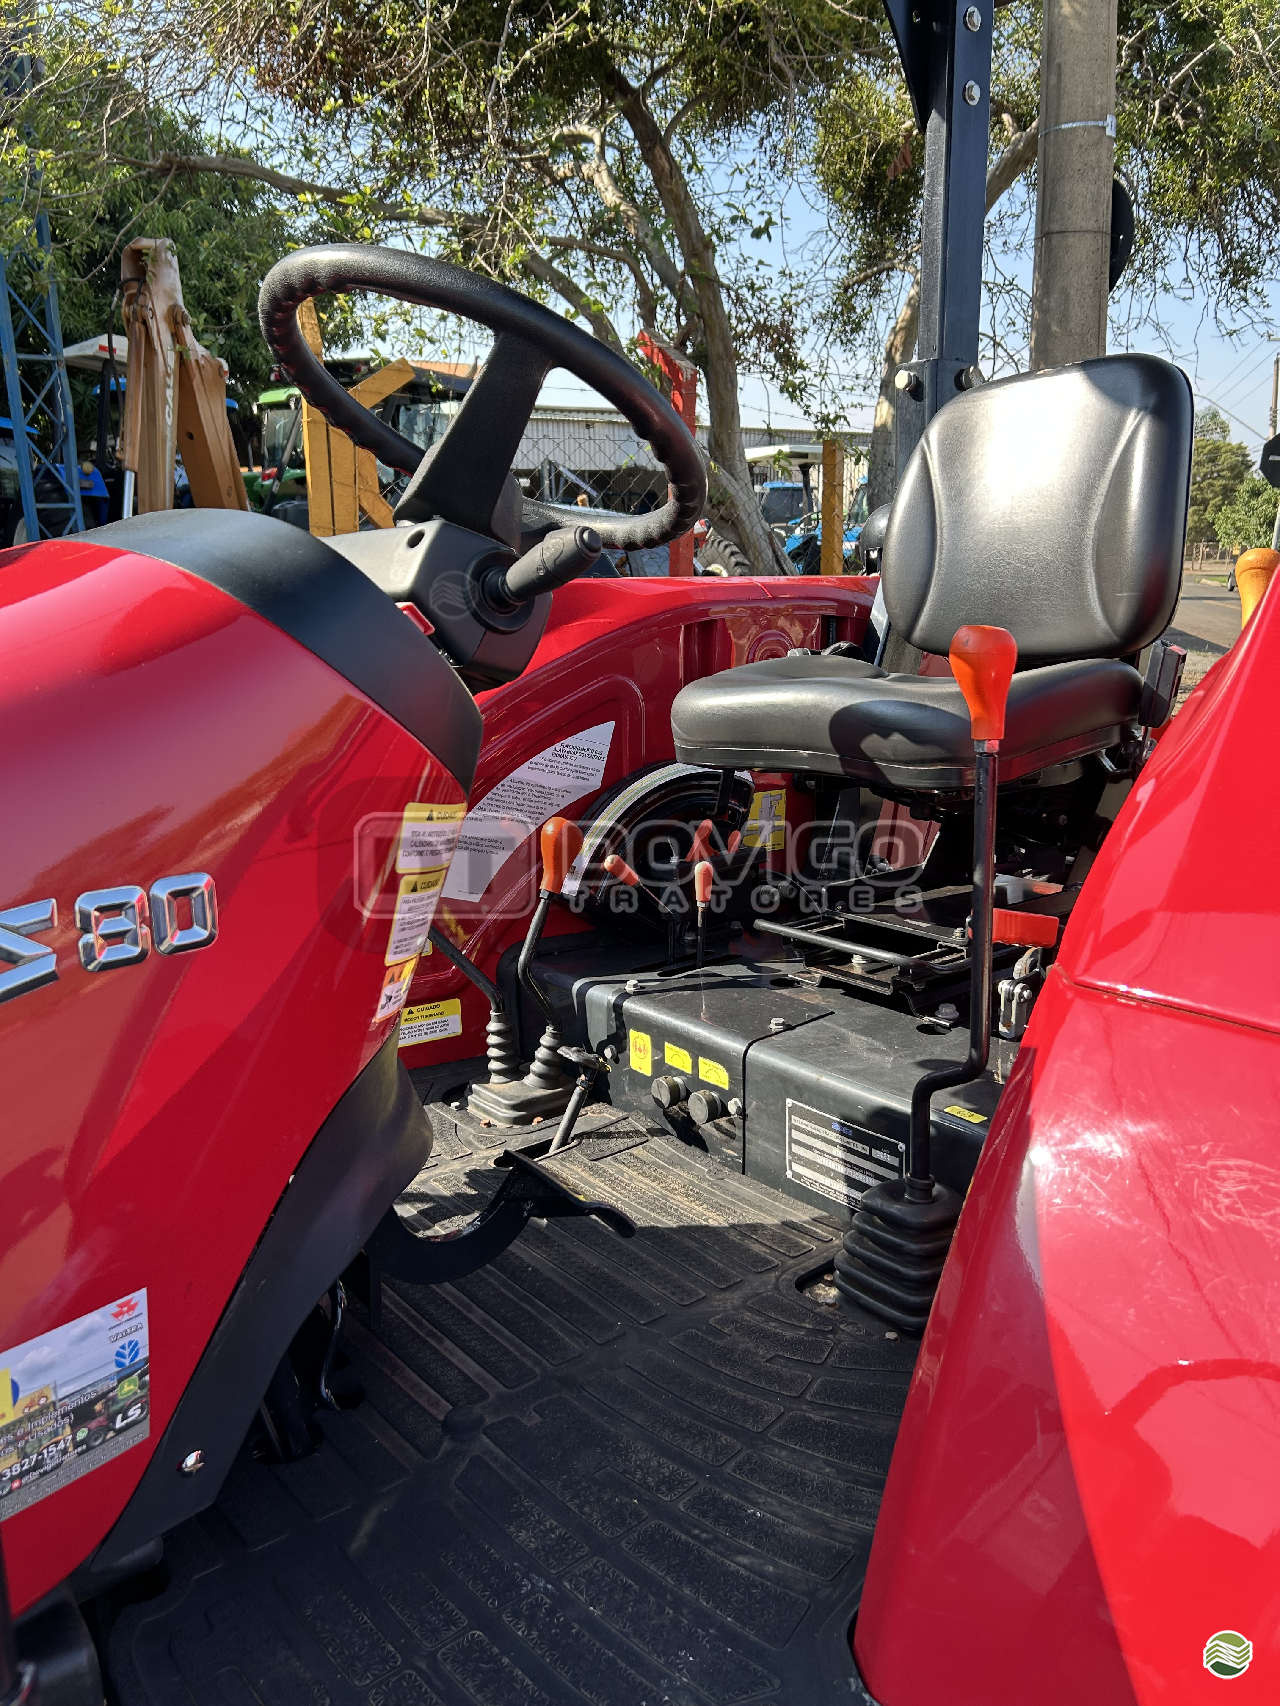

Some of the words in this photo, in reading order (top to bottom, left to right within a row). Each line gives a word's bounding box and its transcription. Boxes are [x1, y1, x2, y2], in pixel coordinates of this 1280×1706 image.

[75, 871, 219, 973] 80
[108, 1322, 144, 1344] VALTRA
[28, 1390, 98, 1431] Implementos
[28, 1412, 75, 1442] Usados)
[115, 1402, 142, 1429] LS
[2, 1434, 74, 1481] 3827-1547
